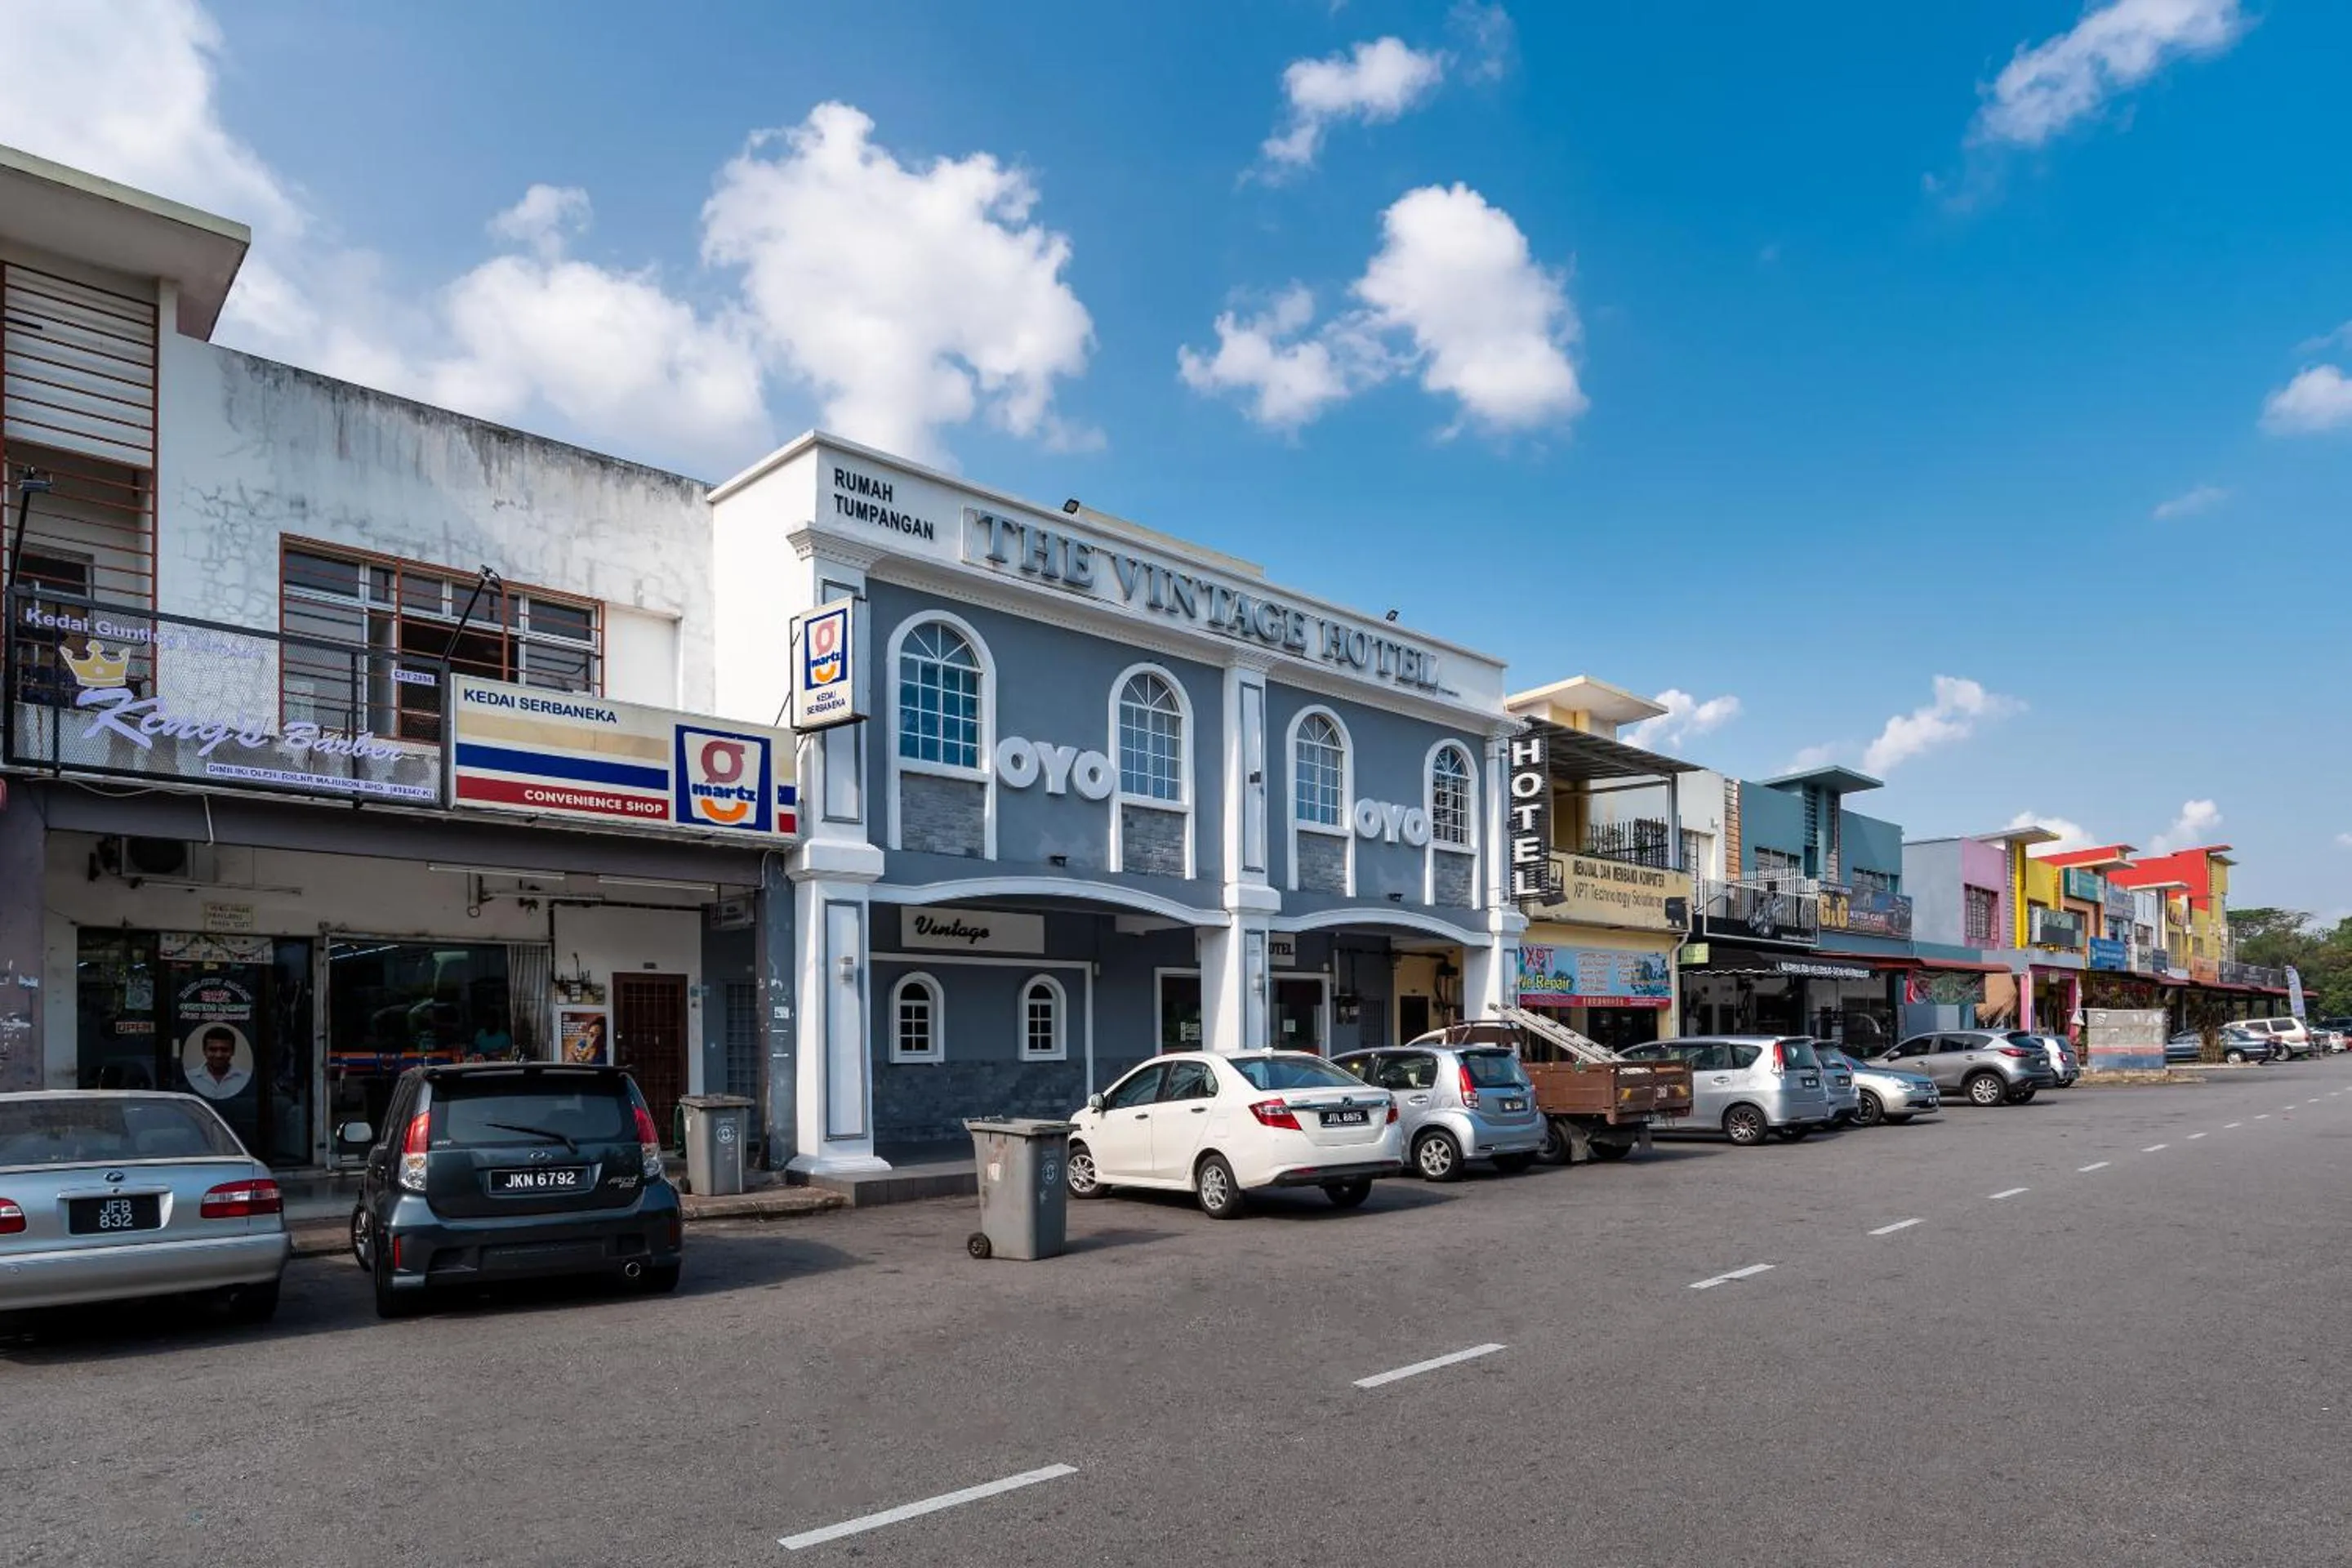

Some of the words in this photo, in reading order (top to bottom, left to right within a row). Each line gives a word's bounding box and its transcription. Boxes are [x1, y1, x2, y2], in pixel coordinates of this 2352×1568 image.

[835, 468, 893, 502] RUMAH
[834, 494, 934, 541] TUMPANGAN
[978, 510, 1094, 588] THE
[1098, 550, 1307, 650] VINTAGE
[1318, 618, 1439, 692] HOTEL
[26, 608, 89, 633] Kedai
[464, 688, 516, 710] KEDAI
[519, 697, 617, 724] SERBANEKA
[807, 698, 846, 715] SERBANEKA
[817, 690, 837, 702] KEDAI
[996, 735, 1115, 801] OYO
[523, 789, 623, 812] CONVENIENCE
[626, 800, 664, 816] SHOP
[691, 781, 757, 803] martz
[1354, 797, 1430, 847] OYO
[1511, 738, 1542, 897] HOTEL
[915, 915, 991, 945] Vintage
[1268, 942, 1294, 956] OTEL
[505, 1174, 533, 1189] JKN
[537, 1172, 576, 1187] 6792
[100, 1200, 131, 1214] JFB
[100, 1213, 132, 1228] 832
